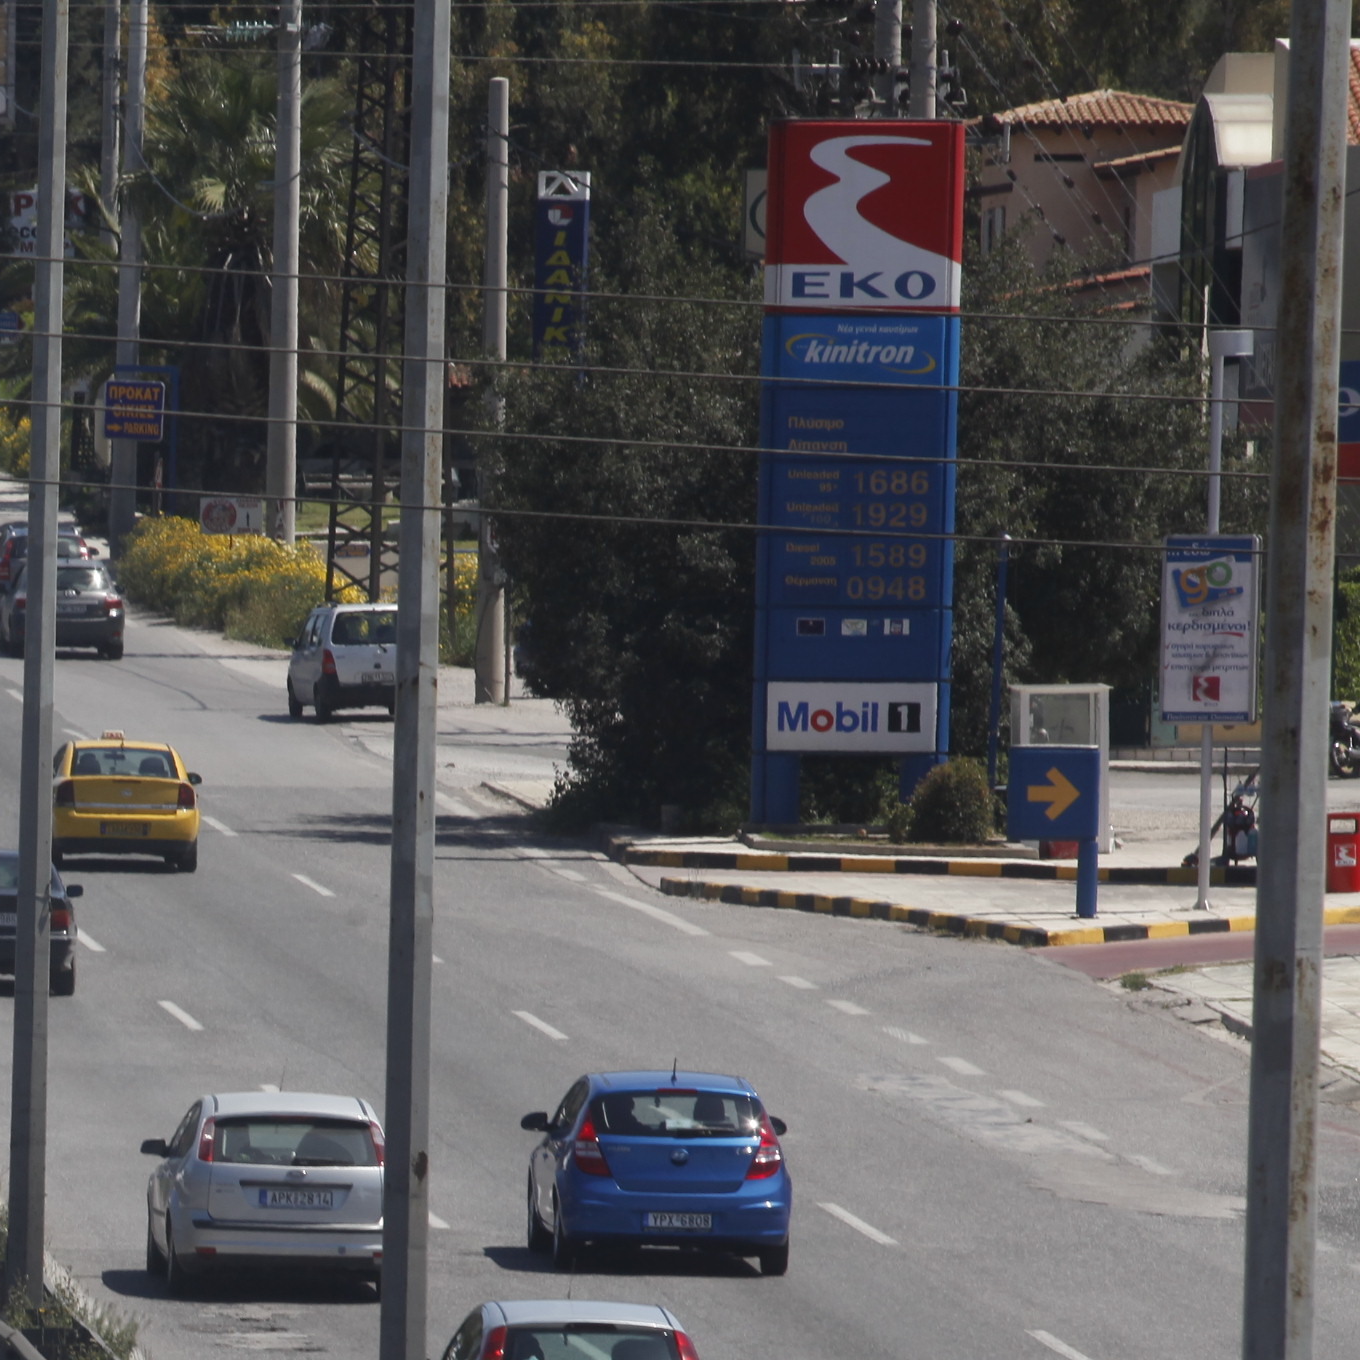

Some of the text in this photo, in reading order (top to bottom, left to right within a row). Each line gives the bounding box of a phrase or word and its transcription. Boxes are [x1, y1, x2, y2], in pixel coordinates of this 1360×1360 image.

[791, 270, 936, 300] EKO
[804, 339, 915, 364] kinitron
[109, 386, 160, 401] ΠΡΟΚΑΤ
[123, 422, 160, 435] PARKING
[788, 469, 840, 479] Unleaded
[778, 701, 878, 733] Mobil
